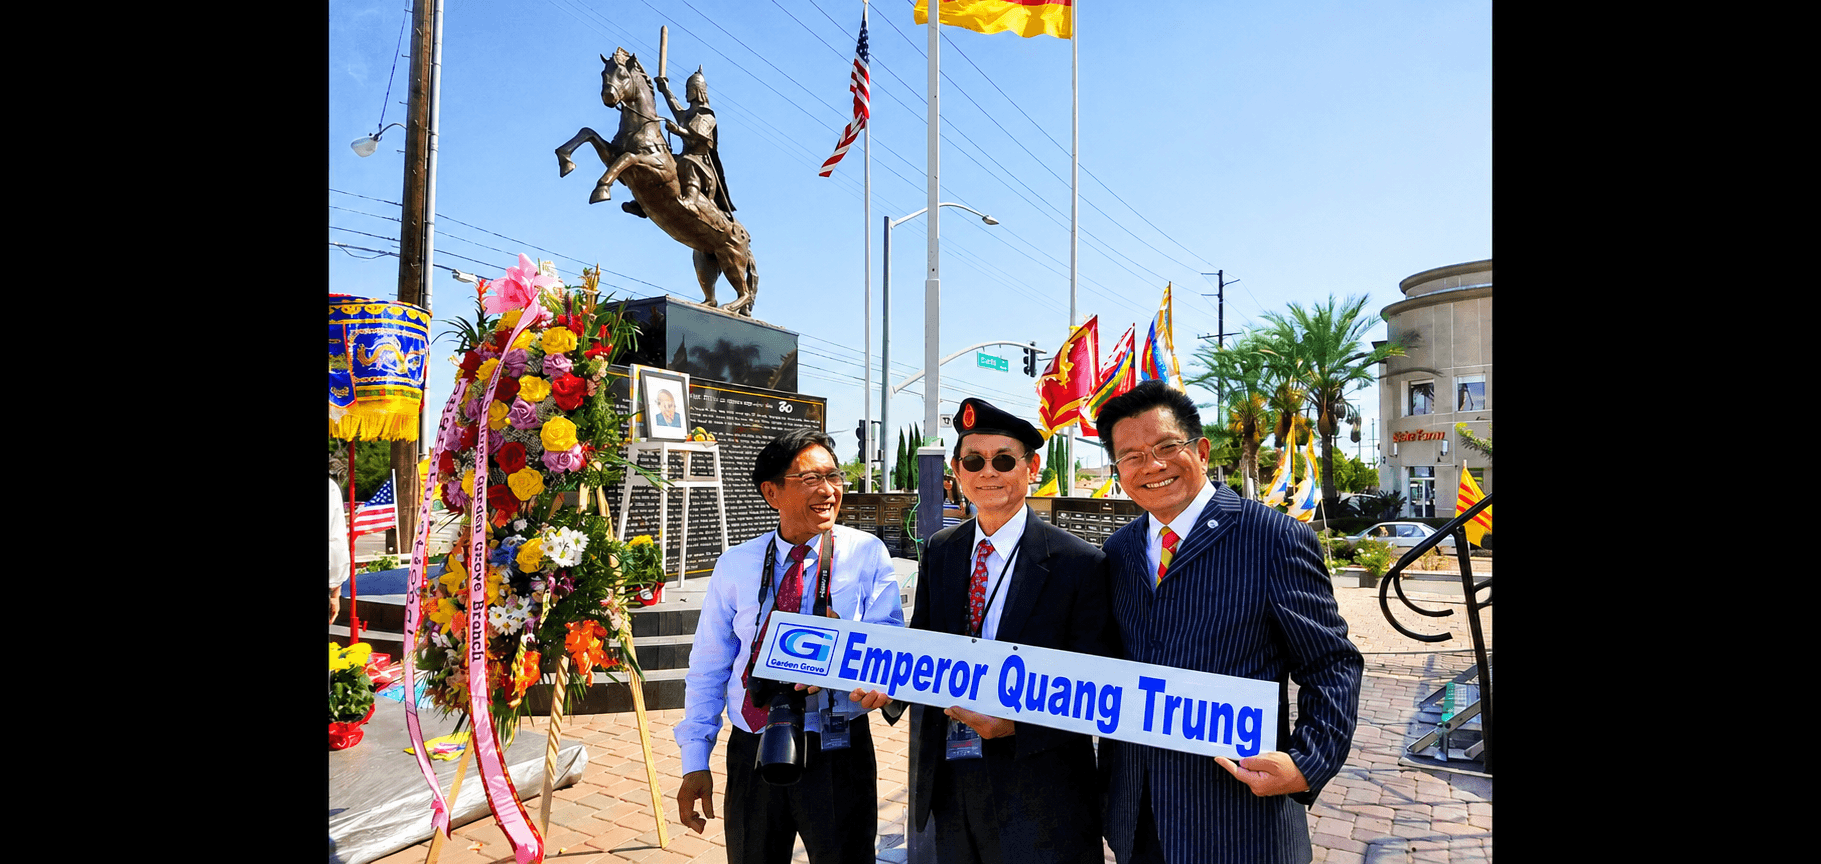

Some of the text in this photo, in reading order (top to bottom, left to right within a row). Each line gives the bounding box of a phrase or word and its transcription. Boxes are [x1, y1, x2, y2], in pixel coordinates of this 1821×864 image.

[471, 600, 485, 663] Branch
[838, 631, 1263, 757] Emperor Quang Trung
